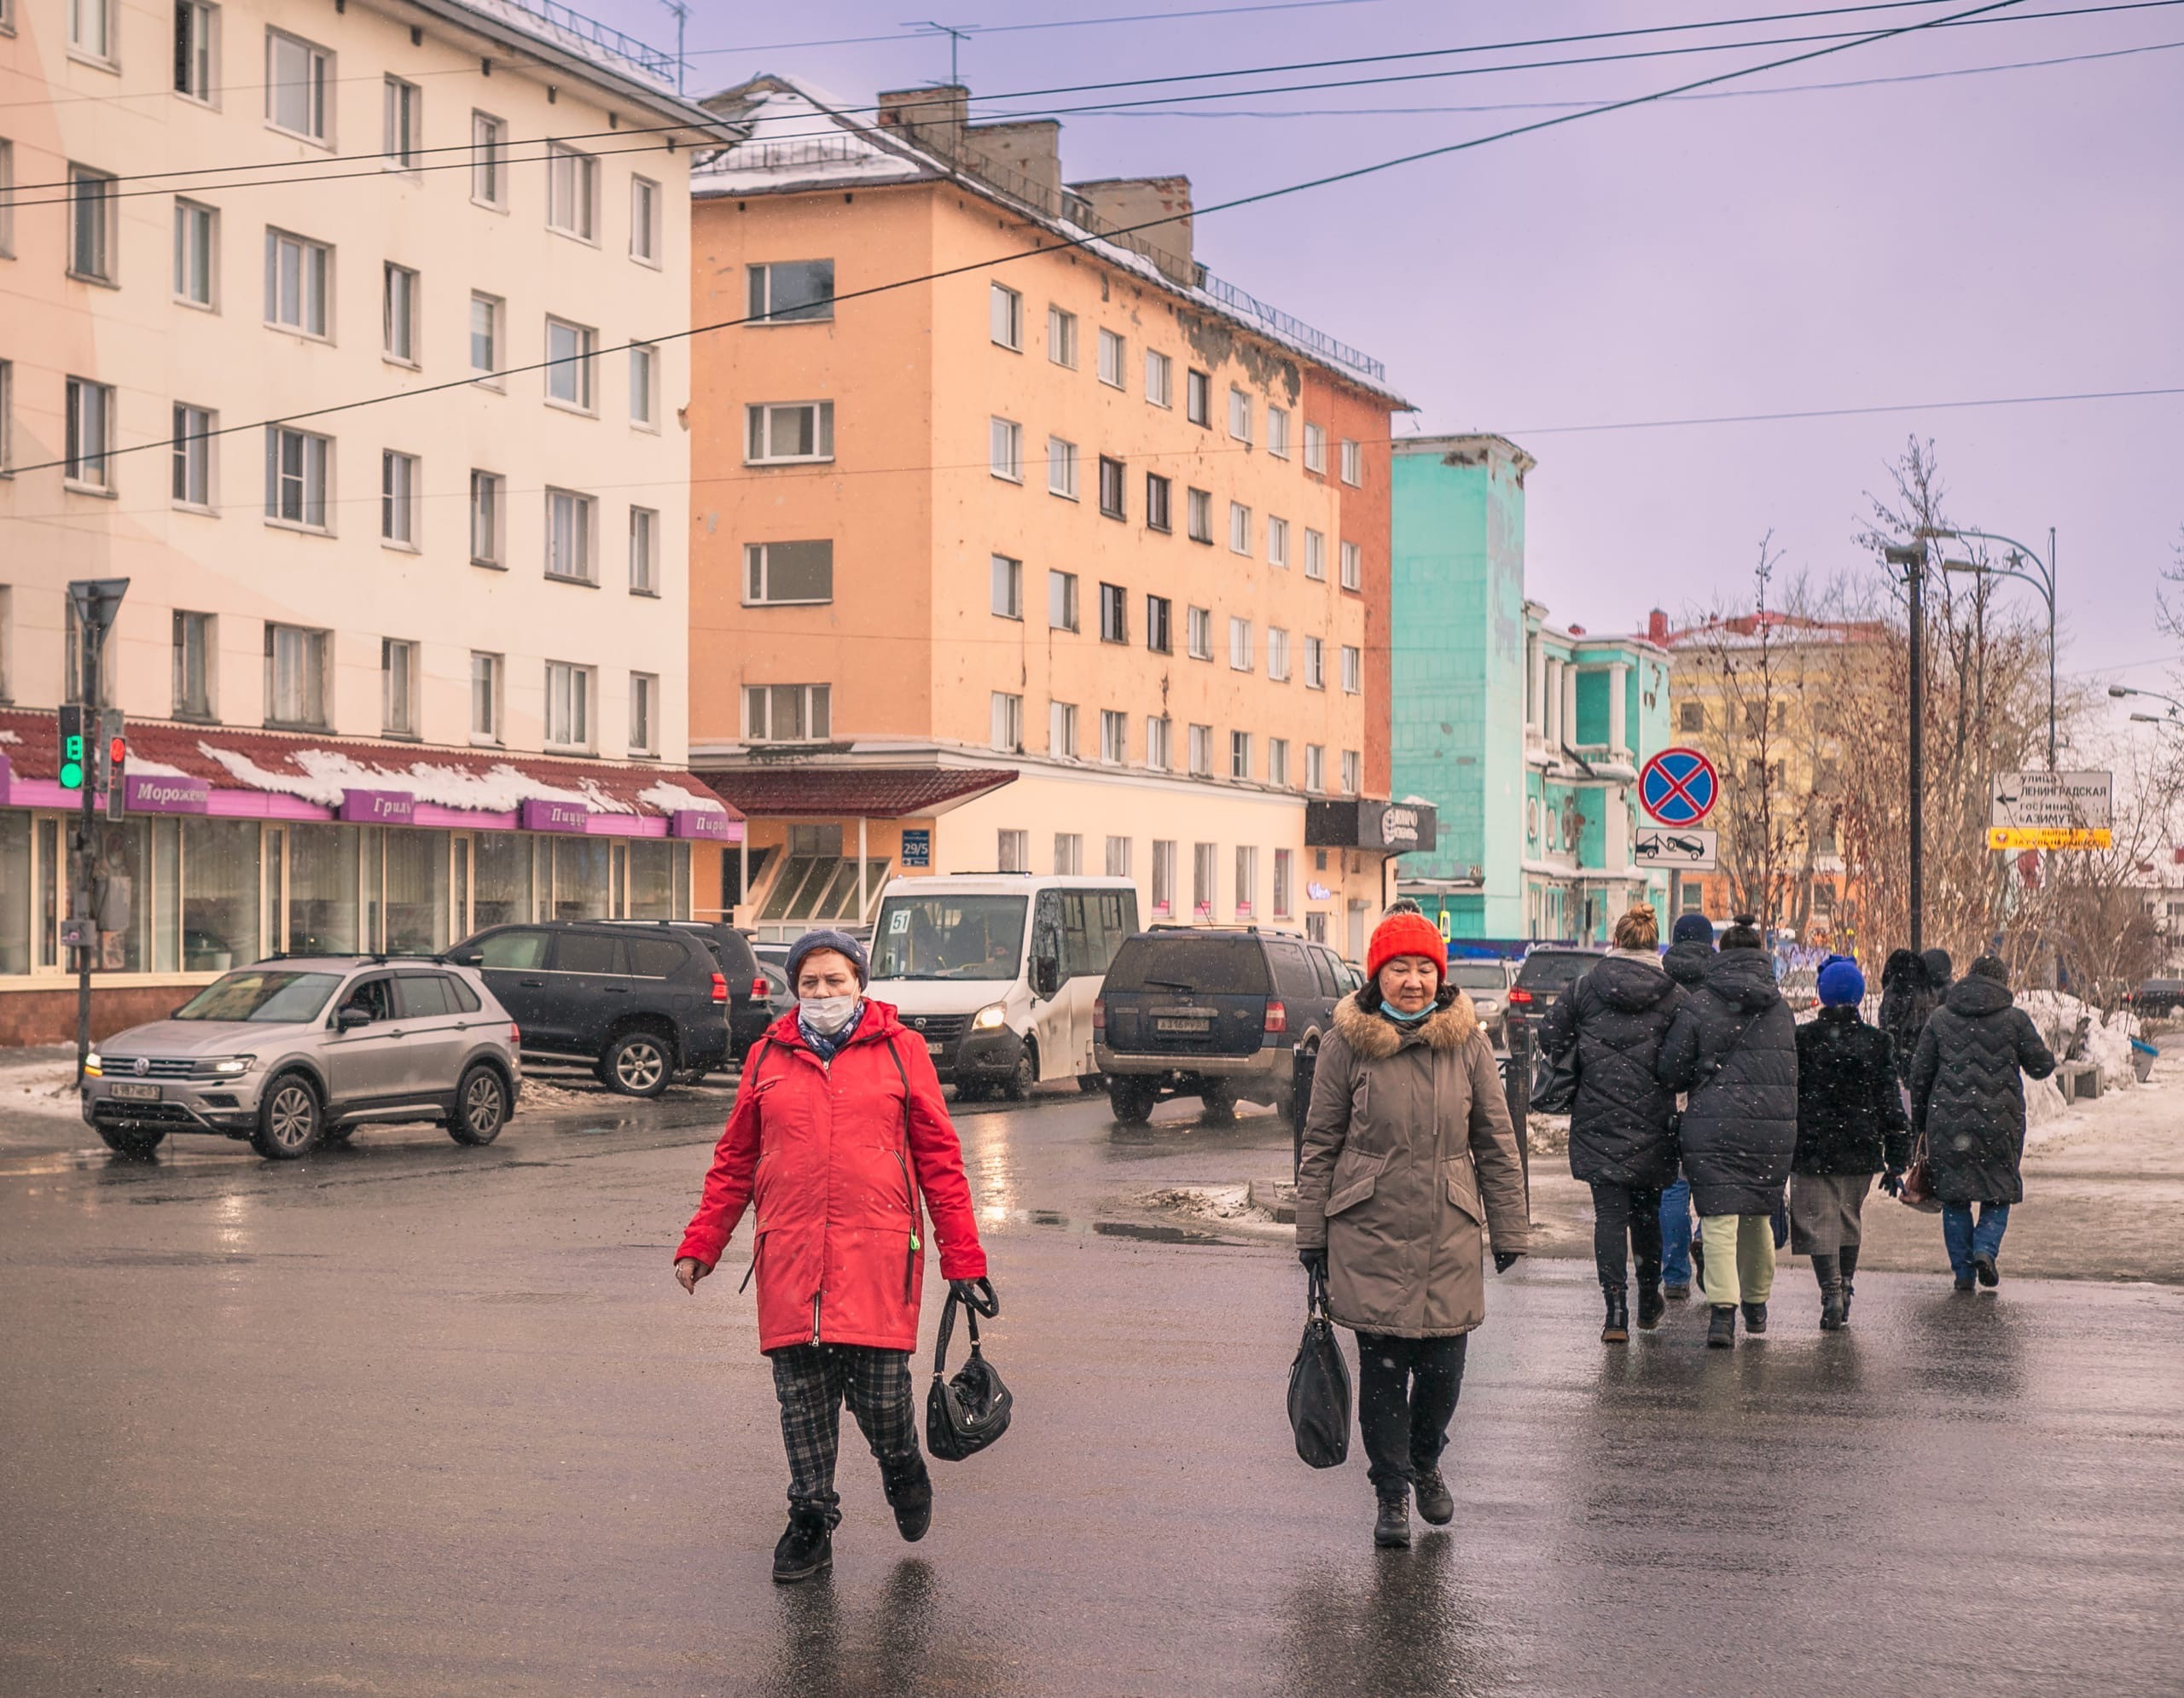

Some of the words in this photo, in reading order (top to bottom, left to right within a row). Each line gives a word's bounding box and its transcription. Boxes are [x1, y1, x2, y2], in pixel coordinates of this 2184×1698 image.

[2019, 775, 2058, 786] улица
[2020, 786, 2107, 798] ЛЕНИНГРАДСКАЯ
[904, 842, 929, 857] 29/5
[892, 914, 908, 930] 51
